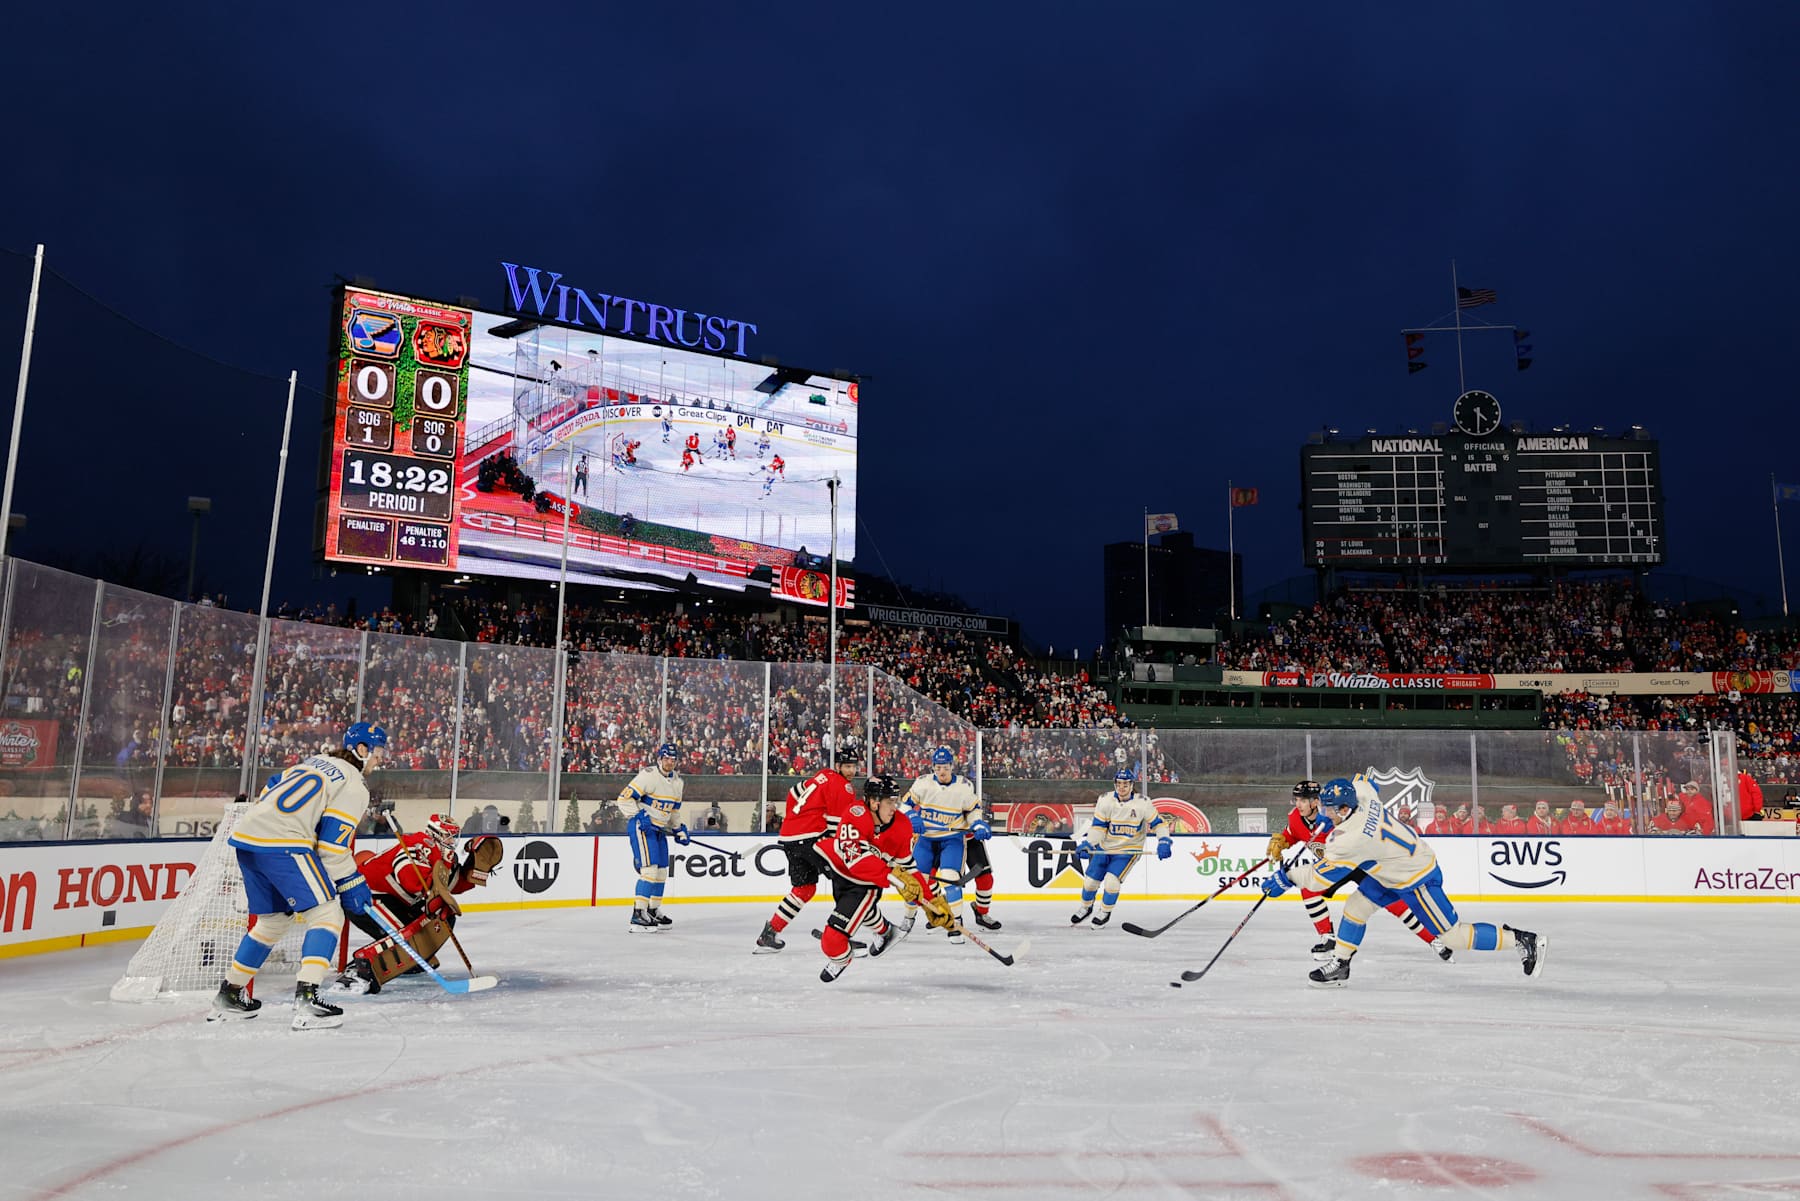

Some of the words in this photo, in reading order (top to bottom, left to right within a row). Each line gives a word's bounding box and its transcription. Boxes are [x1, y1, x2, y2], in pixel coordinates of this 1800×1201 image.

[501, 262, 757, 357] WINTRUST
[357, 365, 388, 400] 0
[422, 376, 452, 410] 0
[358, 410, 381, 427] SOG
[575, 411, 601, 428] HONDA
[602, 407, 642, 419] DISCOVER
[678, 407, 704, 418] Great
[705, 411, 727, 422] Clips
[423, 420, 446, 436] SOG
[737, 415, 755, 430] CAT
[766, 421, 785, 435] CAT
[362, 426, 374, 443] 1
[426, 434, 441, 453] 0
[1371, 439, 1443, 452] NATIONAL
[1464, 443, 1505, 451] OFFICIALS
[1516, 437, 1589, 451] AMERICAN
[1464, 463, 1497, 472] BATTER
[348, 459, 449, 495] 18:22
[369, 491, 417, 512] PERIOD
[346, 519, 385, 532] PENALTIES
[405, 525, 442, 538] PENALTIES
[400, 536, 416, 546] 46
[420, 538, 447, 549] 1:10
[868, 605, 988, 631] WRIGLEYROOFTOPS.COM
[1329, 672, 1389, 689] Winter
[1392, 677, 1444, 688] CLASSIC
[1650, 679, 1672, 687] Great
[1673, 679, 1691, 688] Clips
[1130, 808, 1137, 818] A
[1363, 799, 1381, 838] FOWLER
[840, 823, 860, 840] 86
[1490, 840, 1562, 866] aws
[513, 860, 560, 880] TNT
[667, 852, 747, 878] reat
[1028, 840, 1087, 888] CA
[53, 862, 197, 910] HOND
